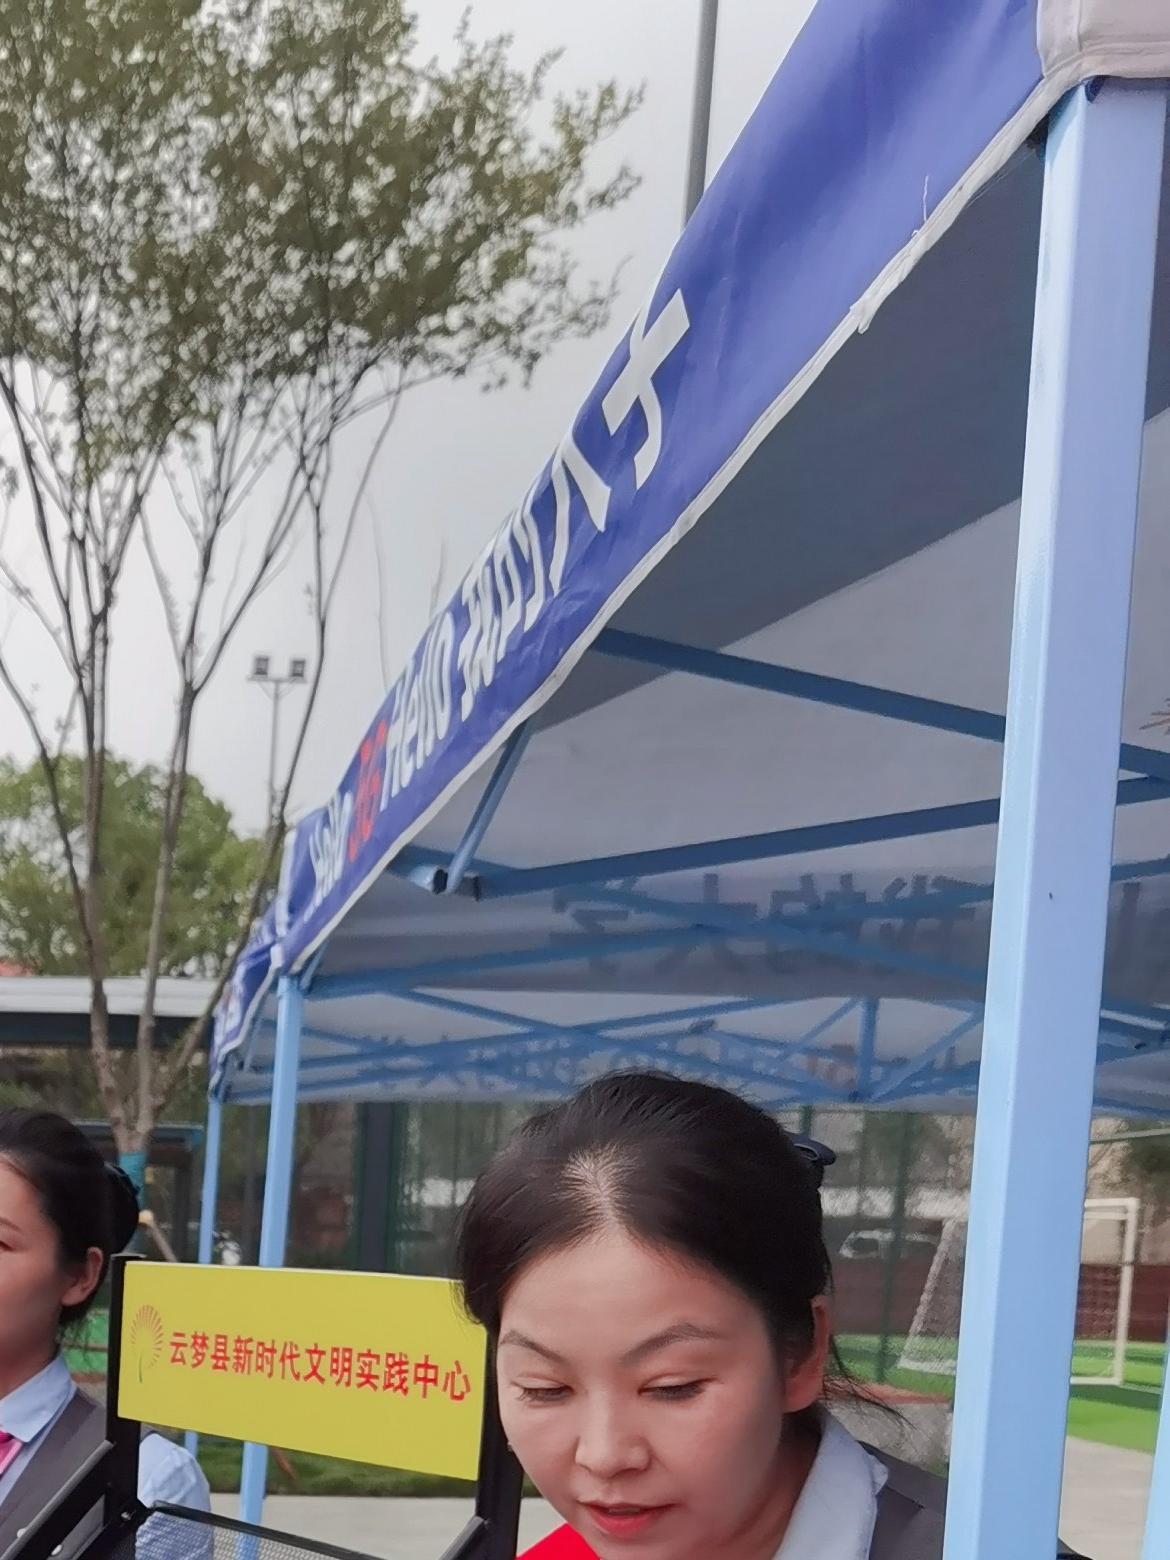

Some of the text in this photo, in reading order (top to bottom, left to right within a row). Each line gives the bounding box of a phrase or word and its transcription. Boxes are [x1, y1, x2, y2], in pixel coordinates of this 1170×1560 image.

[169, 1331, 472, 1402] 云梦县新时代文明实践中心
